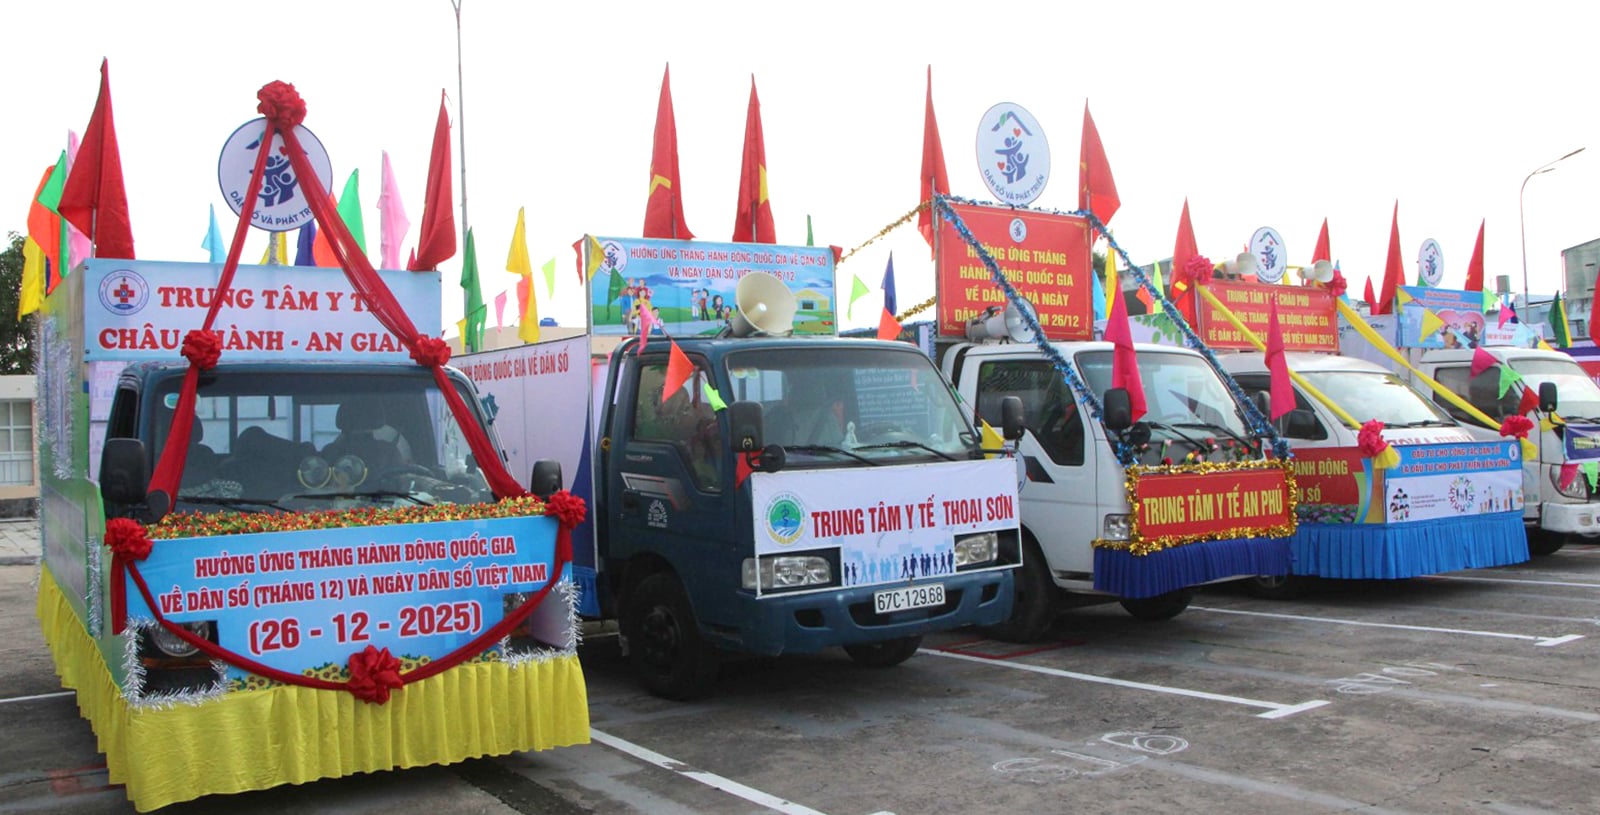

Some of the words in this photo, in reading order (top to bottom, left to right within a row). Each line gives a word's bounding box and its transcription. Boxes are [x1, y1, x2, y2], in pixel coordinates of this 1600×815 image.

[261, 215, 273, 225] VÀ
[276, 215, 298, 225] PHÁT
[776, 254, 787, 265] GIA
[1008, 246, 1030, 262] ỨNG
[1033, 250, 1067, 265] THÁNG
[1026, 268, 1054, 285] QUỐC
[1057, 274, 1074, 287] GIA
[158, 287, 255, 309] TRUNG
[262, 284, 319, 311] TÂM
[326, 292, 343, 311] Y
[982, 287, 1005, 303] DÂN
[1025, 289, 1040, 305] VÀ
[1042, 290, 1069, 307] NGÀY
[1051, 315, 1079, 328] 26/12
[99, 323, 180, 350] CHÂU
[306, 332, 343, 351] AN
[474, 360, 492, 384] ĐỘNG
[494, 354, 512, 381] QUỐC
[514, 358, 527, 377] GIA
[540, 351, 556, 374] DÂN
[558, 345, 569, 373] SỐ
[1295, 458, 1316, 475] ÀNH
[1318, 457, 1348, 479] ĐỘNG
[1143, 495, 1185, 526] TRUNG
[1188, 489, 1215, 522] TÂM
[1216, 493, 1224, 519] Y
[1227, 483, 1240, 519] TẾ
[1243, 490, 1259, 518] AN
[1261, 483, 1282, 515] PHÚ
[1307, 482, 1321, 502] SỐ
[811, 508, 865, 538] TRUNG
[869, 501, 902, 532] TÂM
[905, 504, 914, 530] Y
[918, 494, 935, 528] TẾ
[942, 498, 983, 528] THOẠI
[987, 493, 1014, 521] SƠN
[195, 552, 255, 578] HƯỞNG
[260, 551, 294, 572] ỨNG
[299, 546, 353, 569] THÁNG
[357, 543, 400, 564] HÀNH
[405, 540, 446, 564] ĐỘNG
[450, 532, 487, 561] QUỐC
[491, 537, 515, 554] GIA
[160, 585, 183, 614] VỀ
[188, 588, 224, 611] DÂN
[228, 581, 249, 607] SỐ
[254, 581, 315, 607] (THÁNG
[320, 580, 344, 600] 12)
[348, 574, 368, 596] VÀ
[372, 573, 413, 594] NGÀY
[418, 569, 449, 590] DÂN
[454, 563, 472, 587] SỐ
[476, 565, 508, 589] VIỆT
[512, 564, 546, 583] NAM
[876, 586, 943, 611] 67C-129.68
[249, 618, 300, 655] (26
[332, 612, 369, 643] 12
[379, 622, 390, 630] -
[400, 602, 481, 637] 2025)
